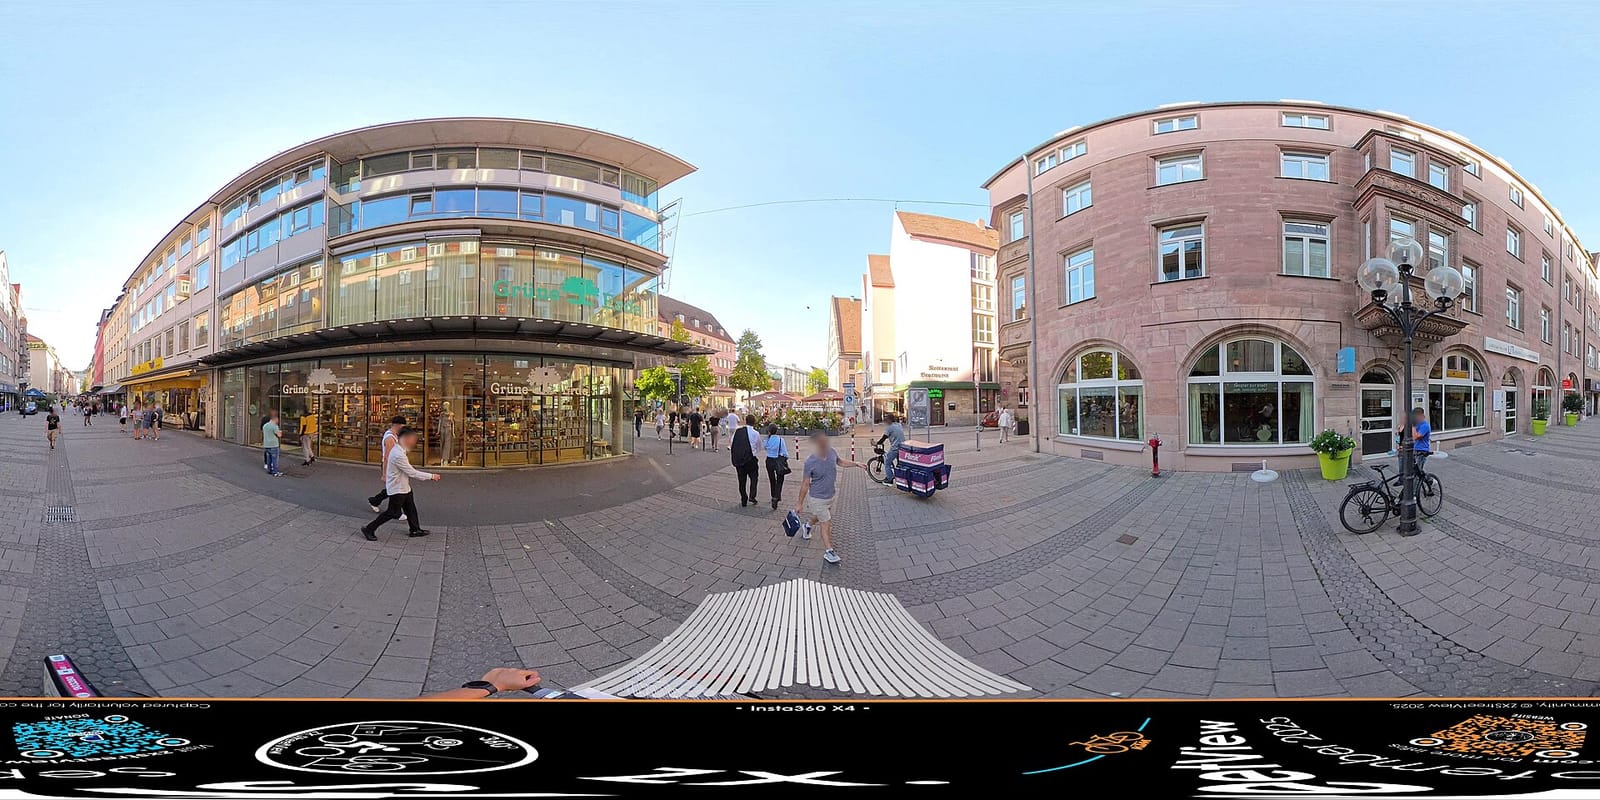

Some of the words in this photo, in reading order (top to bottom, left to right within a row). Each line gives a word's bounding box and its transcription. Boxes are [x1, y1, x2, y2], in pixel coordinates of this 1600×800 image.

[492, 279, 561, 301] Grüne
[282, 384, 309, 394] Grüne
[336, 382, 363, 394] Erde
[490, 382, 529, 394] Grüne
